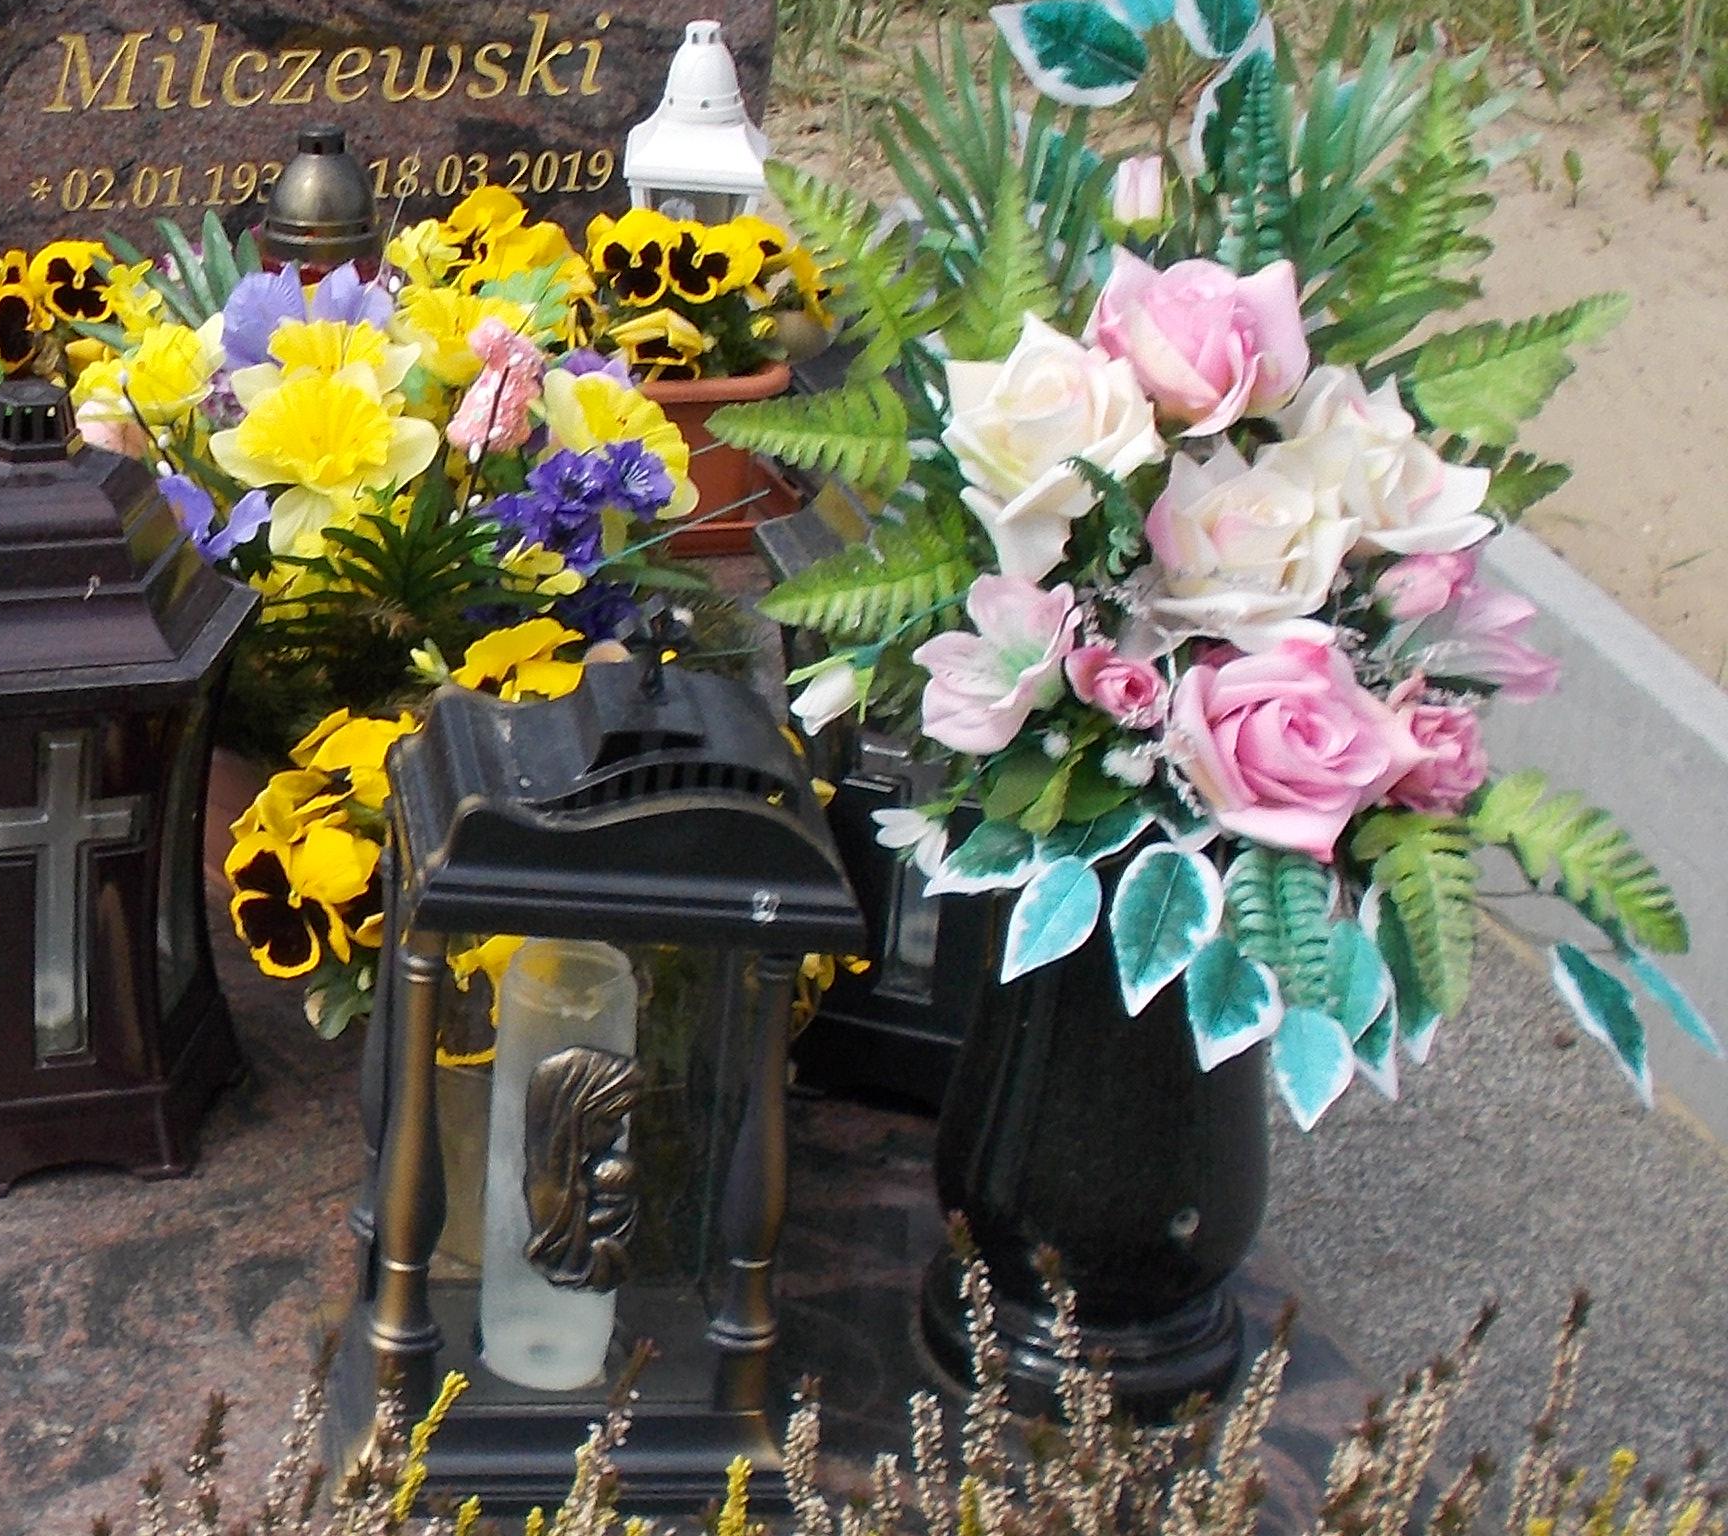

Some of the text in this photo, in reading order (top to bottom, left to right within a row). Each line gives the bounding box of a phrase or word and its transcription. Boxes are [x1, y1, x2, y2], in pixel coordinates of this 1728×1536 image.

[41, 11, 612, 114] Milczewski
[28, 148, 615, 212] 02.01.193 18.032019
